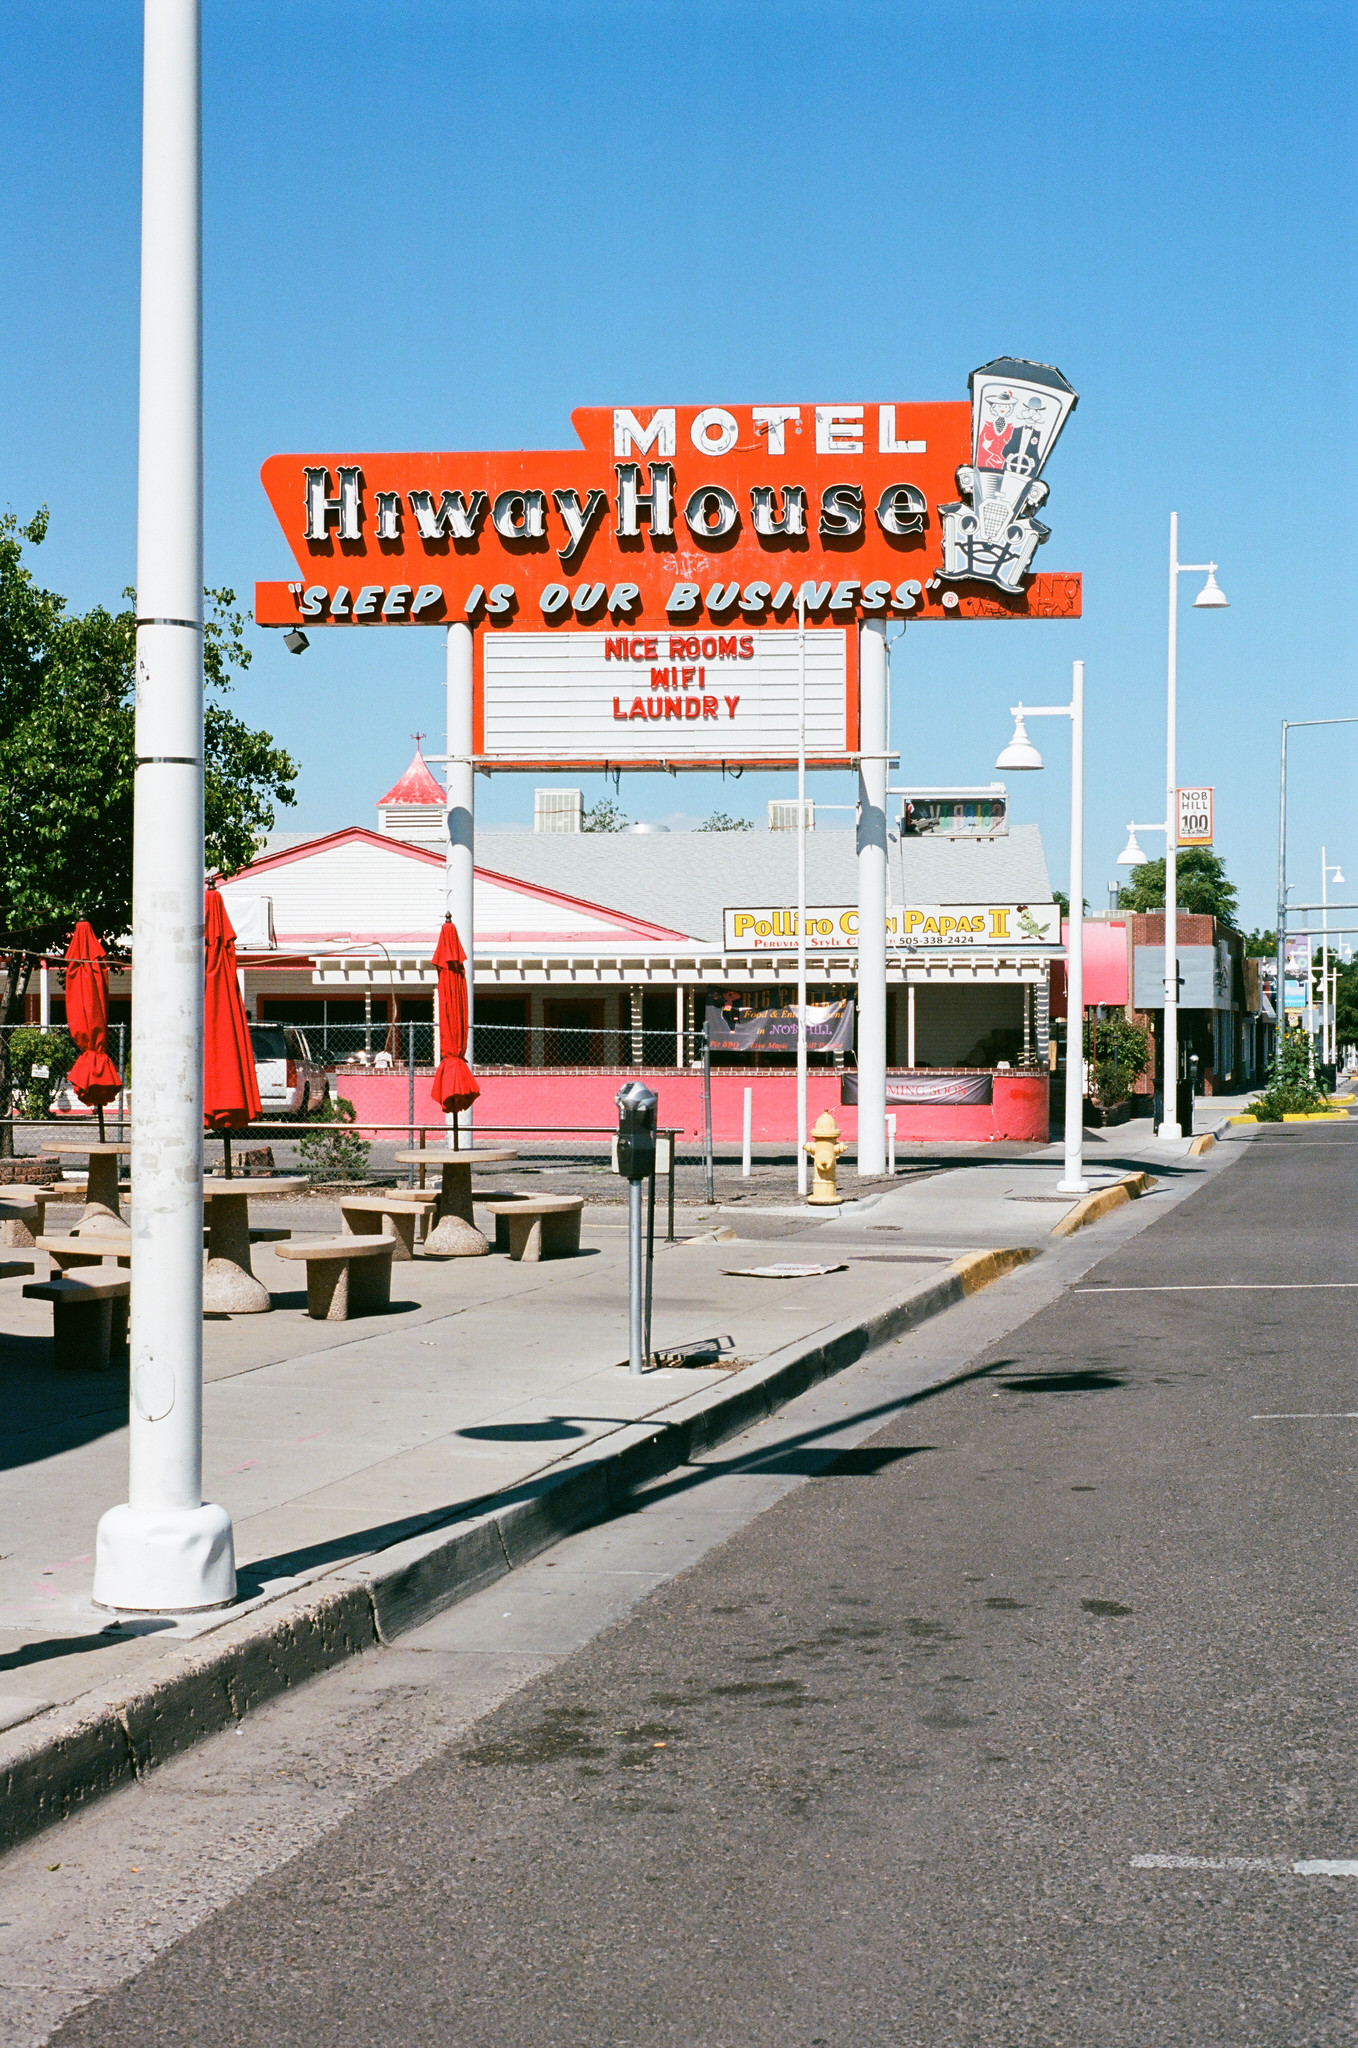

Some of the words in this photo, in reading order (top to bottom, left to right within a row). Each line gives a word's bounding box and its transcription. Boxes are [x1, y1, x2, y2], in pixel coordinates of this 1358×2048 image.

[613, 404, 927, 457] MOTEL
[464, 583, 515, 613] IS
[539, 582, 640, 613] OUR
[604, 637, 658, 659] NICE
[669, 635, 755, 659] ROOMS
[650, 666, 705, 689] WIFI
[612, 695, 740, 719] LAUNDRY
[1181, 791, 1208, 801] NOB
[1181, 801, 1208, 810] HILL
[1181, 814, 1209, 831] 100
[988, 909, 1010, 938] II
[899, 936, 974, 945] 505-338-2424
[743, 1010, 768, 1018] Food
[769, 1010, 778, 1018] &
[929, 1085, 967, 1096] SOON
